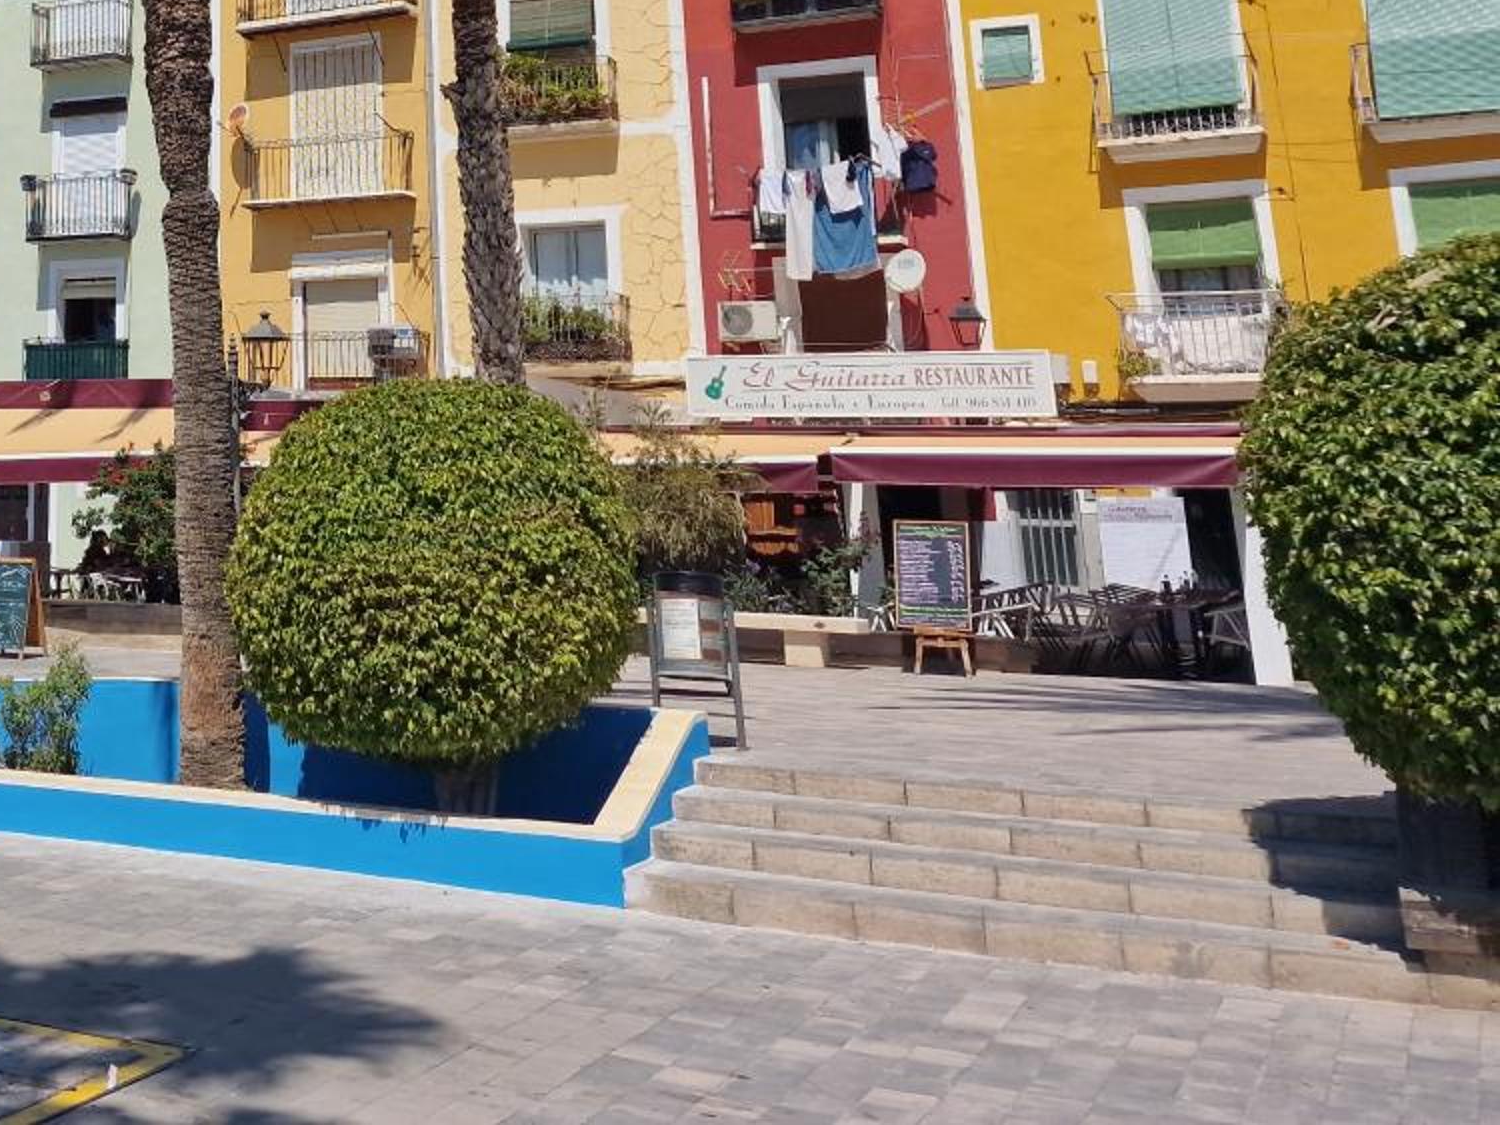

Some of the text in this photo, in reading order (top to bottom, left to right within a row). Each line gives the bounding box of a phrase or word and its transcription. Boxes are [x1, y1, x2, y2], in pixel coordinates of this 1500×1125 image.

[743, 362, 774, 387] El
[914, 366, 1035, 387] RESTAURANTE
[725, 394, 775, 410] Comida
